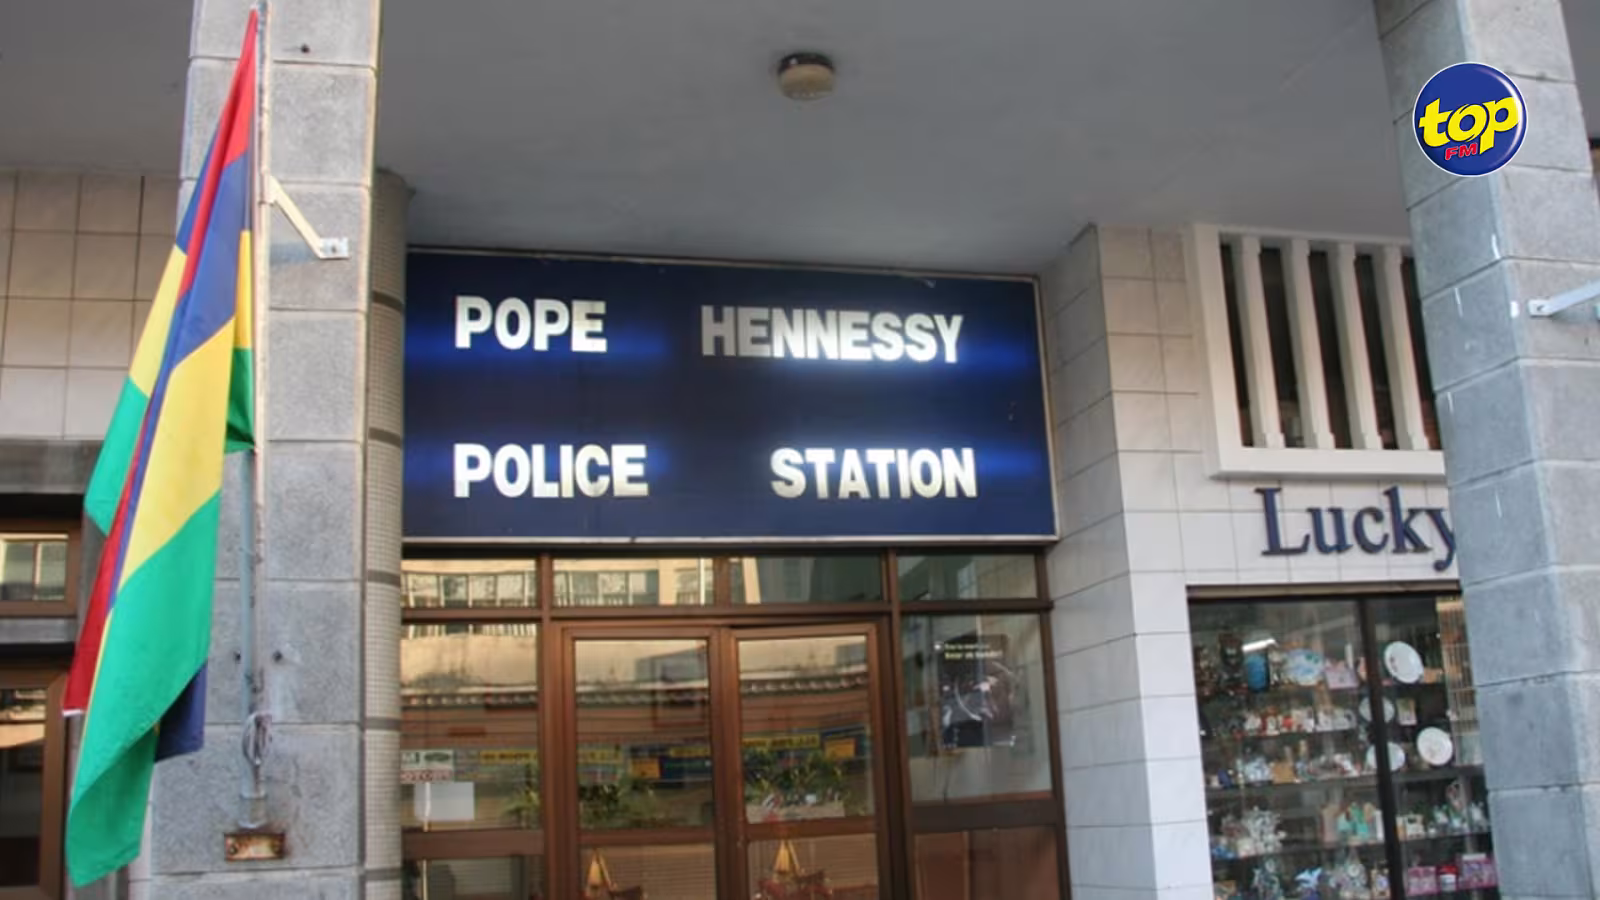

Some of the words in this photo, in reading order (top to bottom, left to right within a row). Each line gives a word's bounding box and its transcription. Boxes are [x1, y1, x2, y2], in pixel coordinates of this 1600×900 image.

[455, 296, 607, 353] POPE
[701, 305, 963, 363] HENNESSY
[453, 443, 649, 499] POLICE
[770, 446, 978, 500] STATION
[1254, 485, 1456, 572] Lucky
